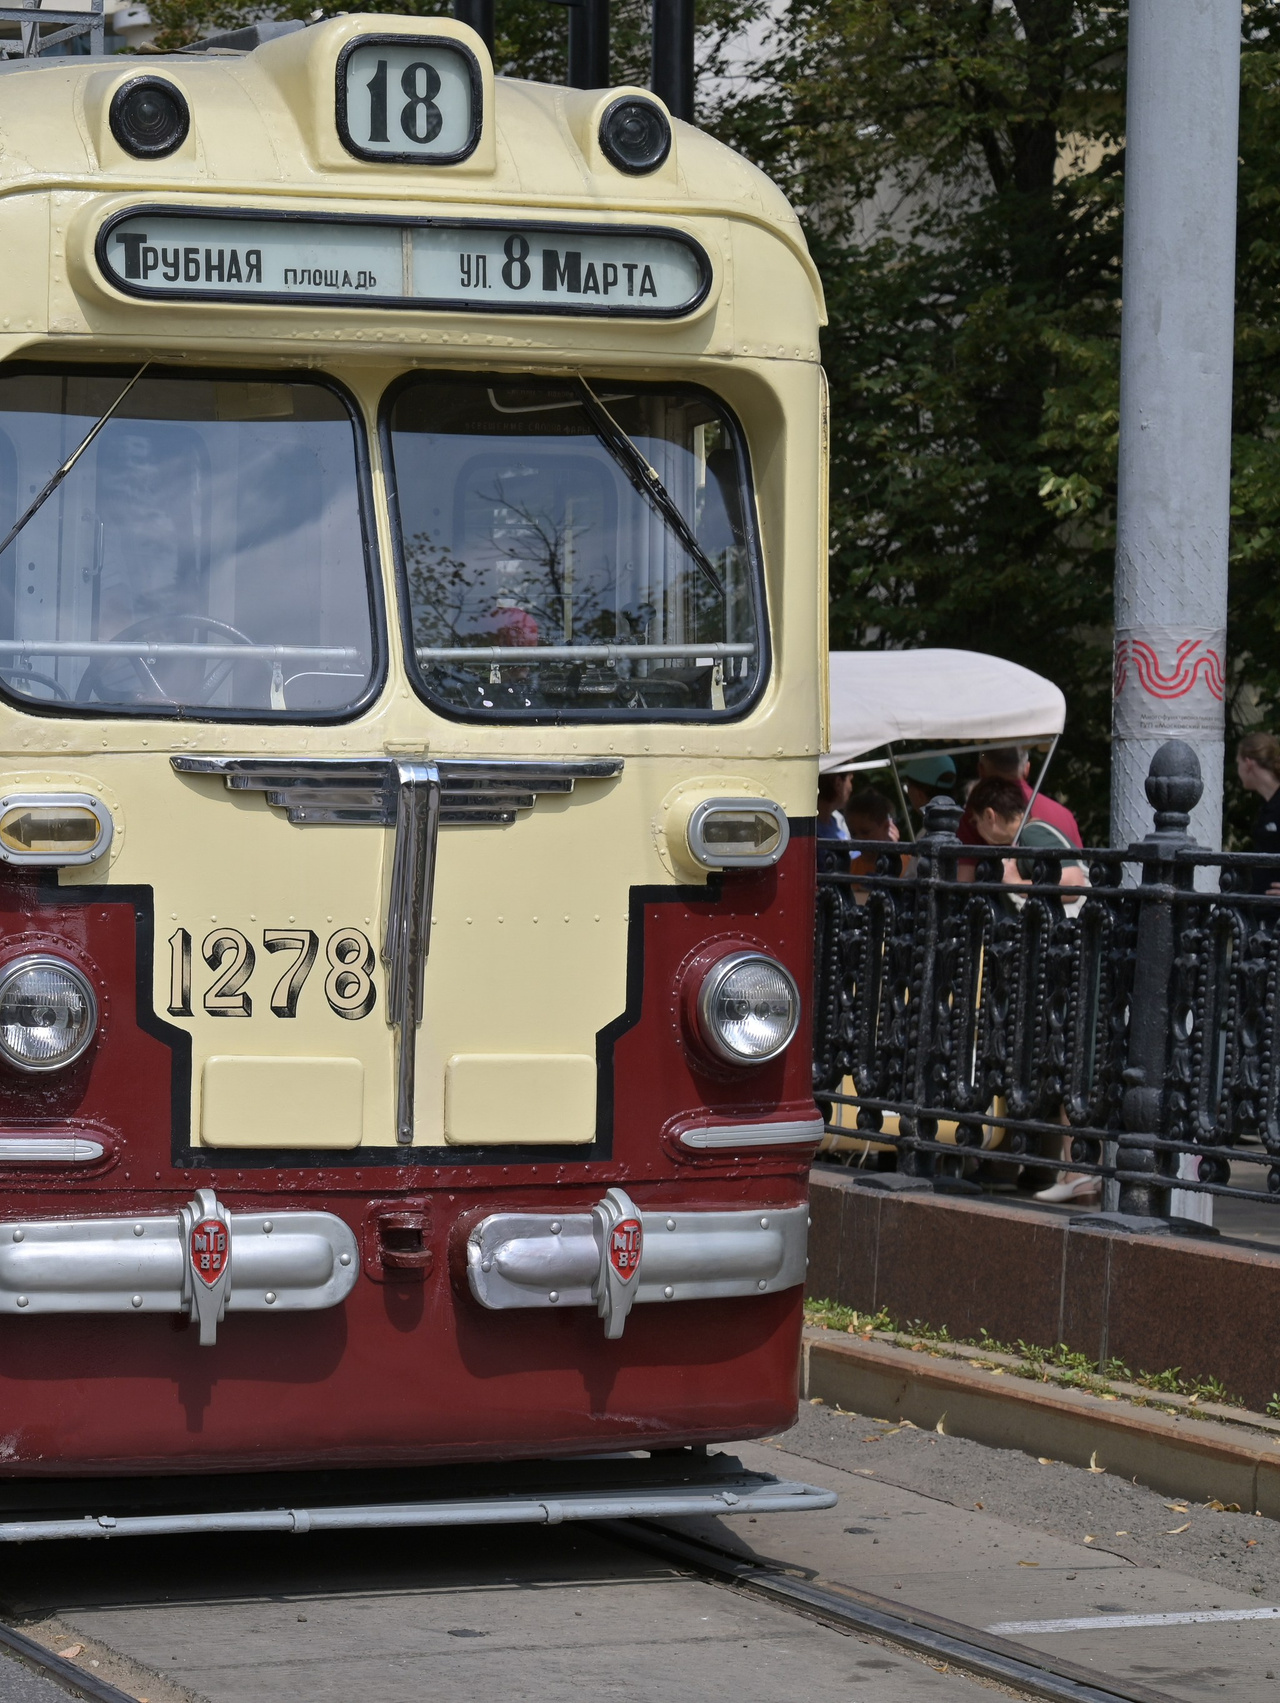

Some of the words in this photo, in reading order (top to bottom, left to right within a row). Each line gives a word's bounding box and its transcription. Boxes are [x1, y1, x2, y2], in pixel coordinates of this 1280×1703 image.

[365, 59, 443, 144] 18
[116, 232, 262, 283] ТРУБНАЯ
[284, 268, 377, 290] ПЛОЩАДЬ
[502, 233, 531, 290] 8
[542, 249, 657, 297] МАРТА
[167, 927, 377, 1020] 1278
[200, 1254, 221, 1269] 82
